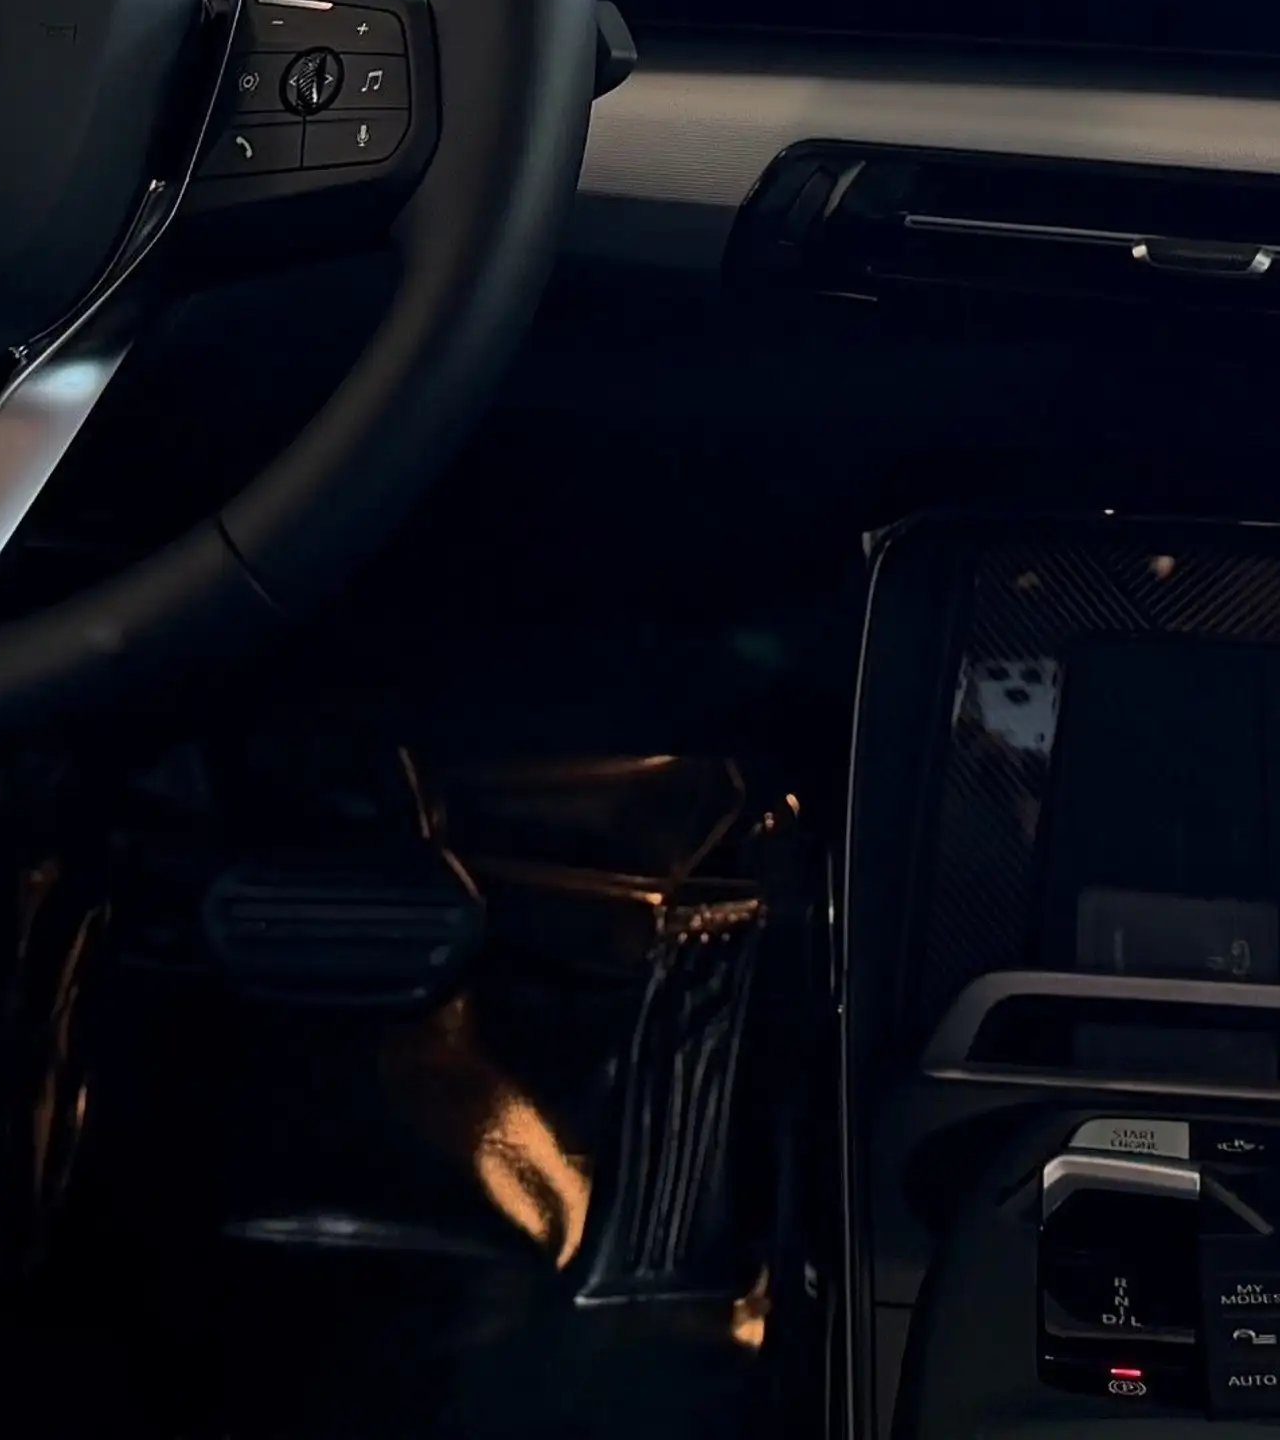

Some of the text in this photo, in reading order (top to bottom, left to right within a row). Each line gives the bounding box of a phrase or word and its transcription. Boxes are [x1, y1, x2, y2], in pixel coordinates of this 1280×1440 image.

[1112, 1130, 1155, 1141] START
[1236, 1284, 1263, 1295] MY
[1228, 1375, 1276, 1387] AUTO
